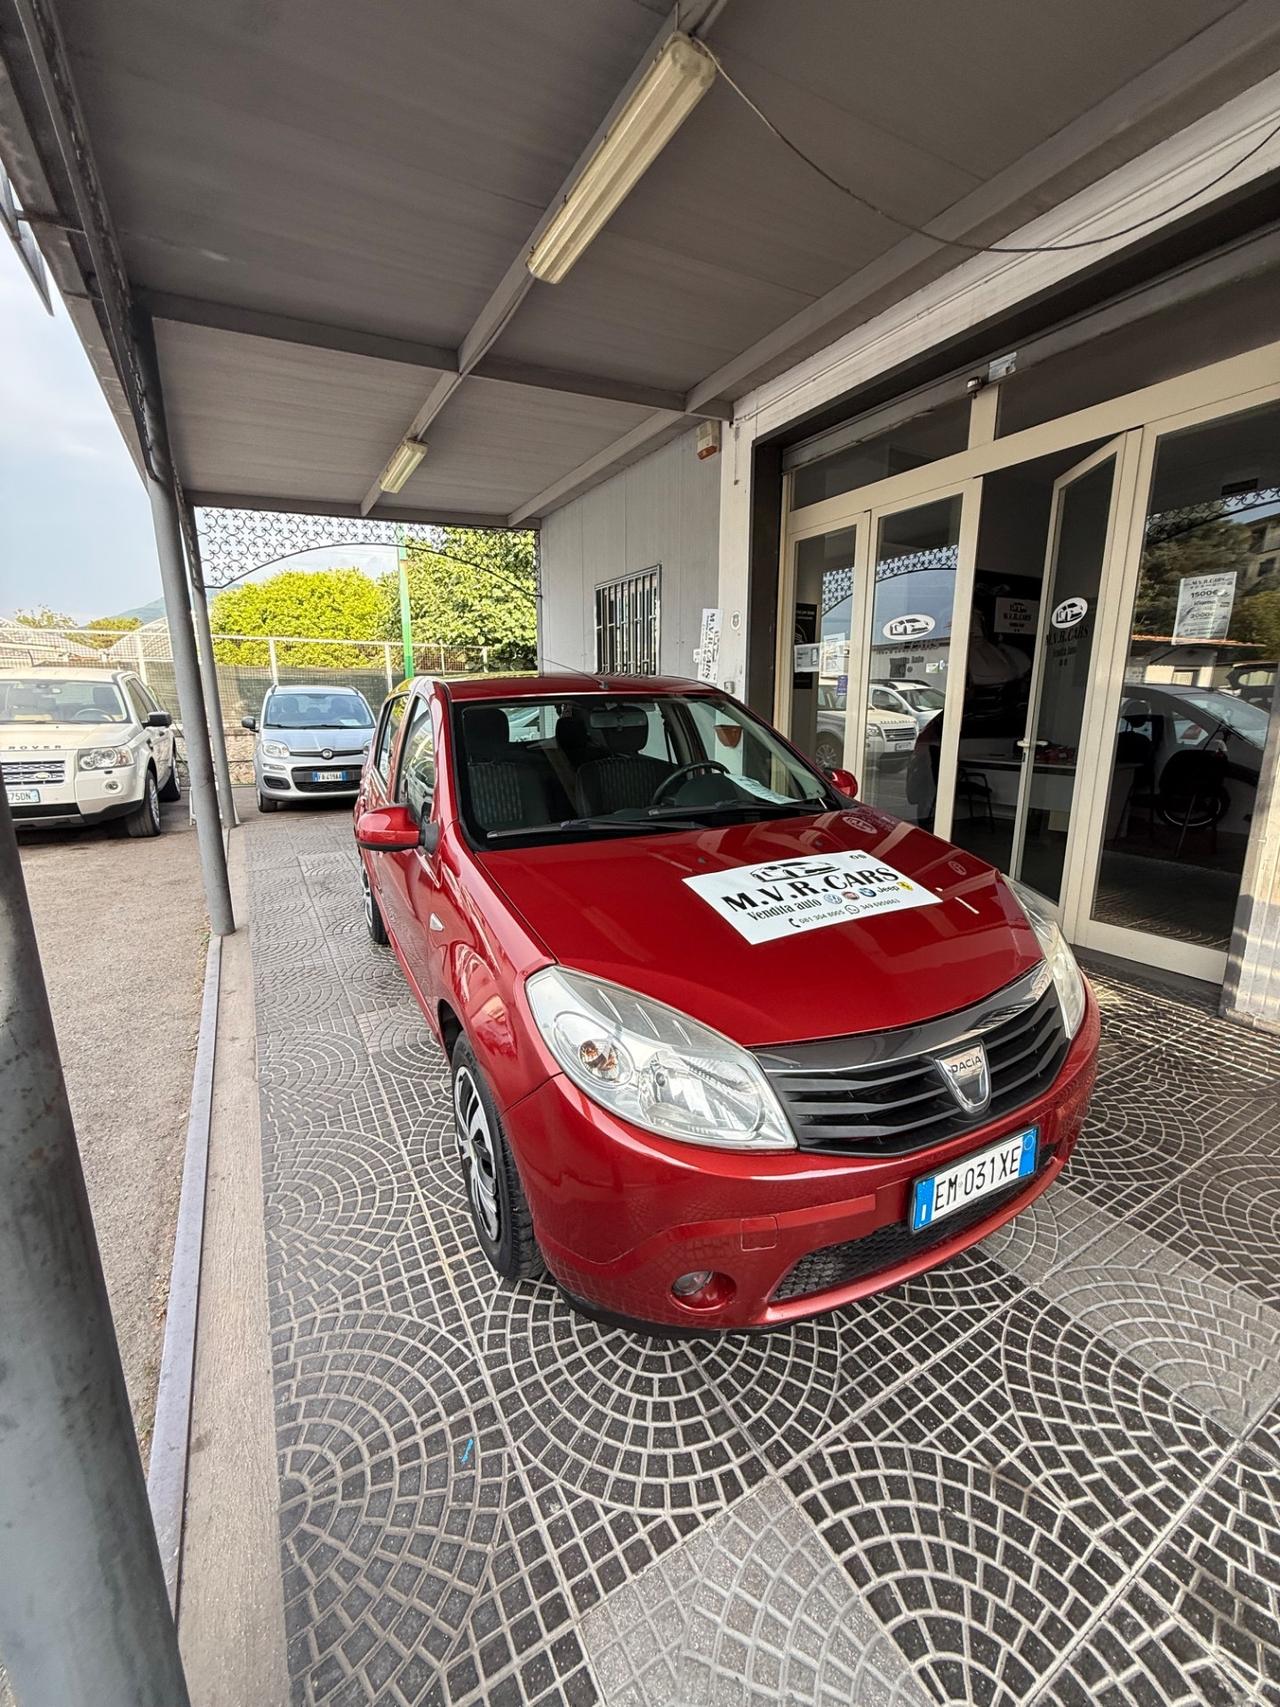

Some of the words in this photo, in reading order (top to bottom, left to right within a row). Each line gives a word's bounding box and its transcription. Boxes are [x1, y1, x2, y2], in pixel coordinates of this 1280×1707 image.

[9, 792, 31, 801] 75DN
[721, 867, 899, 912] M.V.R.CARS
[747, 904, 795, 921] Vendita
[794, 897, 822, 912] auto
[951, 1055, 982, 1074] DACIA
